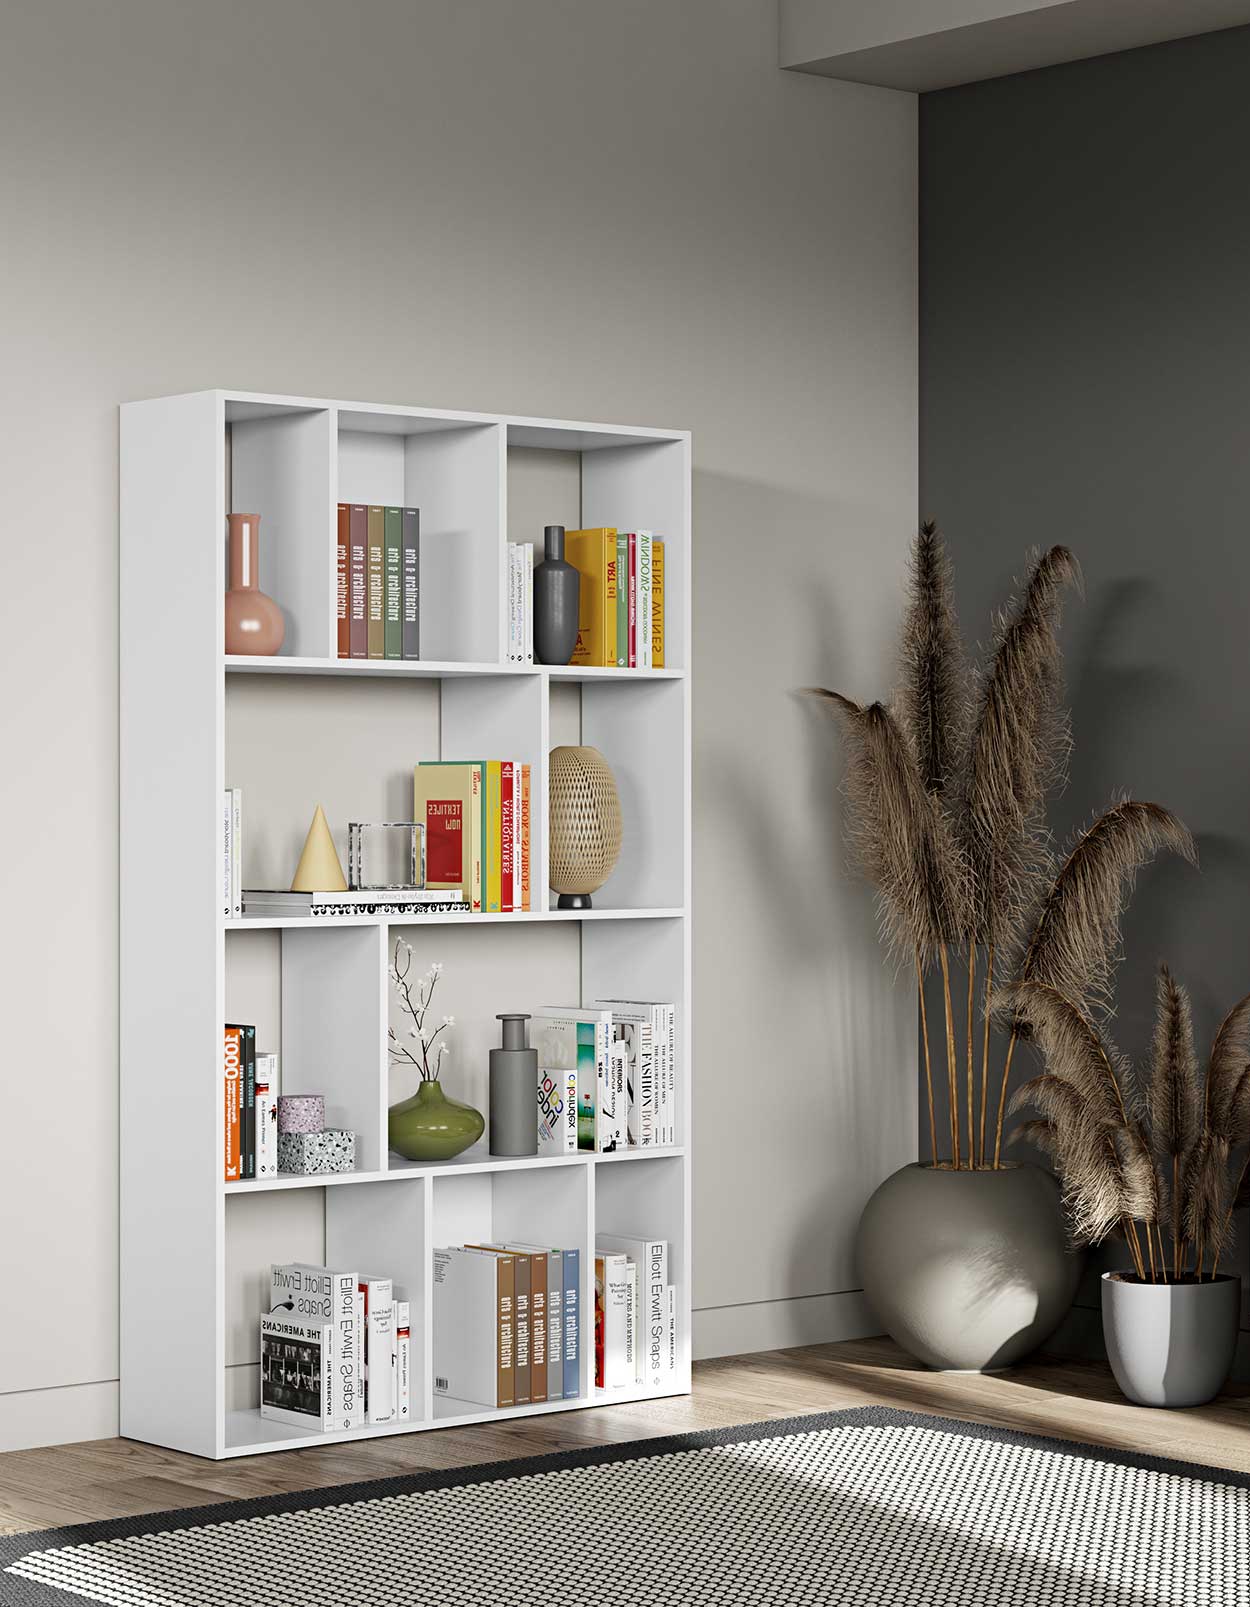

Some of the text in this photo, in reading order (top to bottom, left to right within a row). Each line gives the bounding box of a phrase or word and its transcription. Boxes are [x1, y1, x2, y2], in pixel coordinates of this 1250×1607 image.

[642, 1024, 652, 1051] THE
[669, 1054, 673, 1062] OF
[642, 1053, 652, 1107] FASHION
[650, 1245, 662, 1369] Elliott Erwitt Snaps
